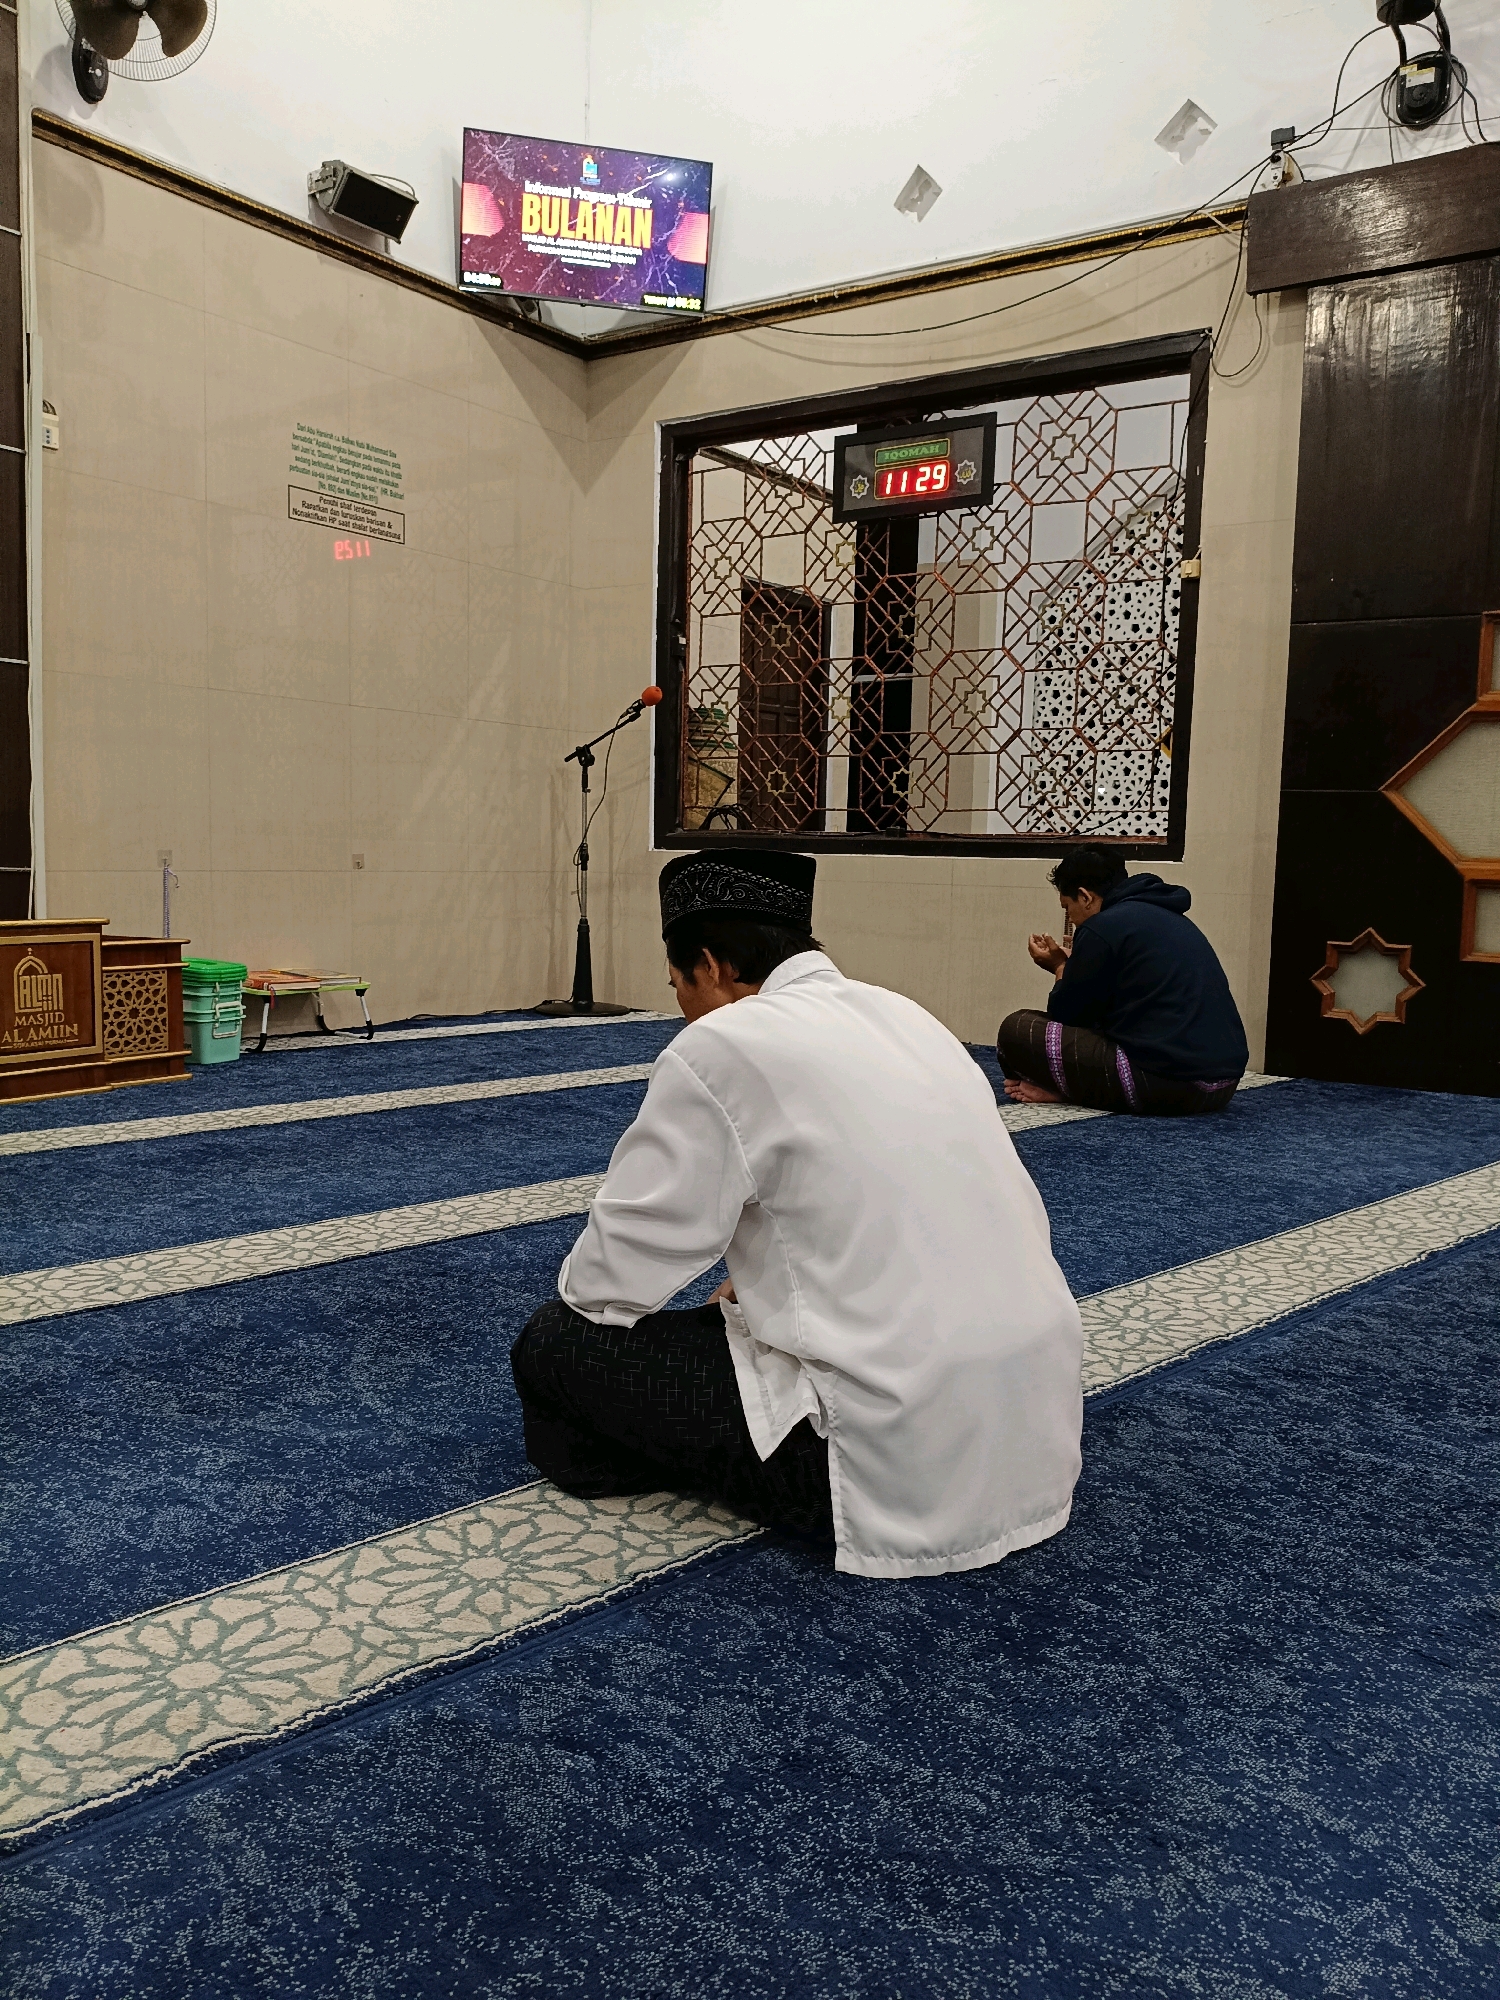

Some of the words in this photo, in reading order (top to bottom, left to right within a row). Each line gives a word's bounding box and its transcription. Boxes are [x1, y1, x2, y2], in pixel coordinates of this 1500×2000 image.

[521, 192, 653, 249] BULANAN
[296, 422, 306, 431] Dari
[307, 426, 315, 435] Abu
[355, 440, 365, 449] Nabi
[365, 442, 389, 456] Muhammad
[884, 444, 940, 460] IQOMAH
[301, 500, 328, 514] Rapatkan
[330, 507, 340, 517] dan
[366, 516, 386, 528] barisan
[387, 521, 393, 529] &
[319, 496, 338, 507] Penuhi
[340, 500, 352, 510] shaf
[353, 505, 377, 517] terdepan
[328, 515, 337, 524] HP
[14, 1012, 65, 1026] MASJID
[1, 1029, 24, 1043] AL
[26, 1023, 79, 1041] AMIIN
